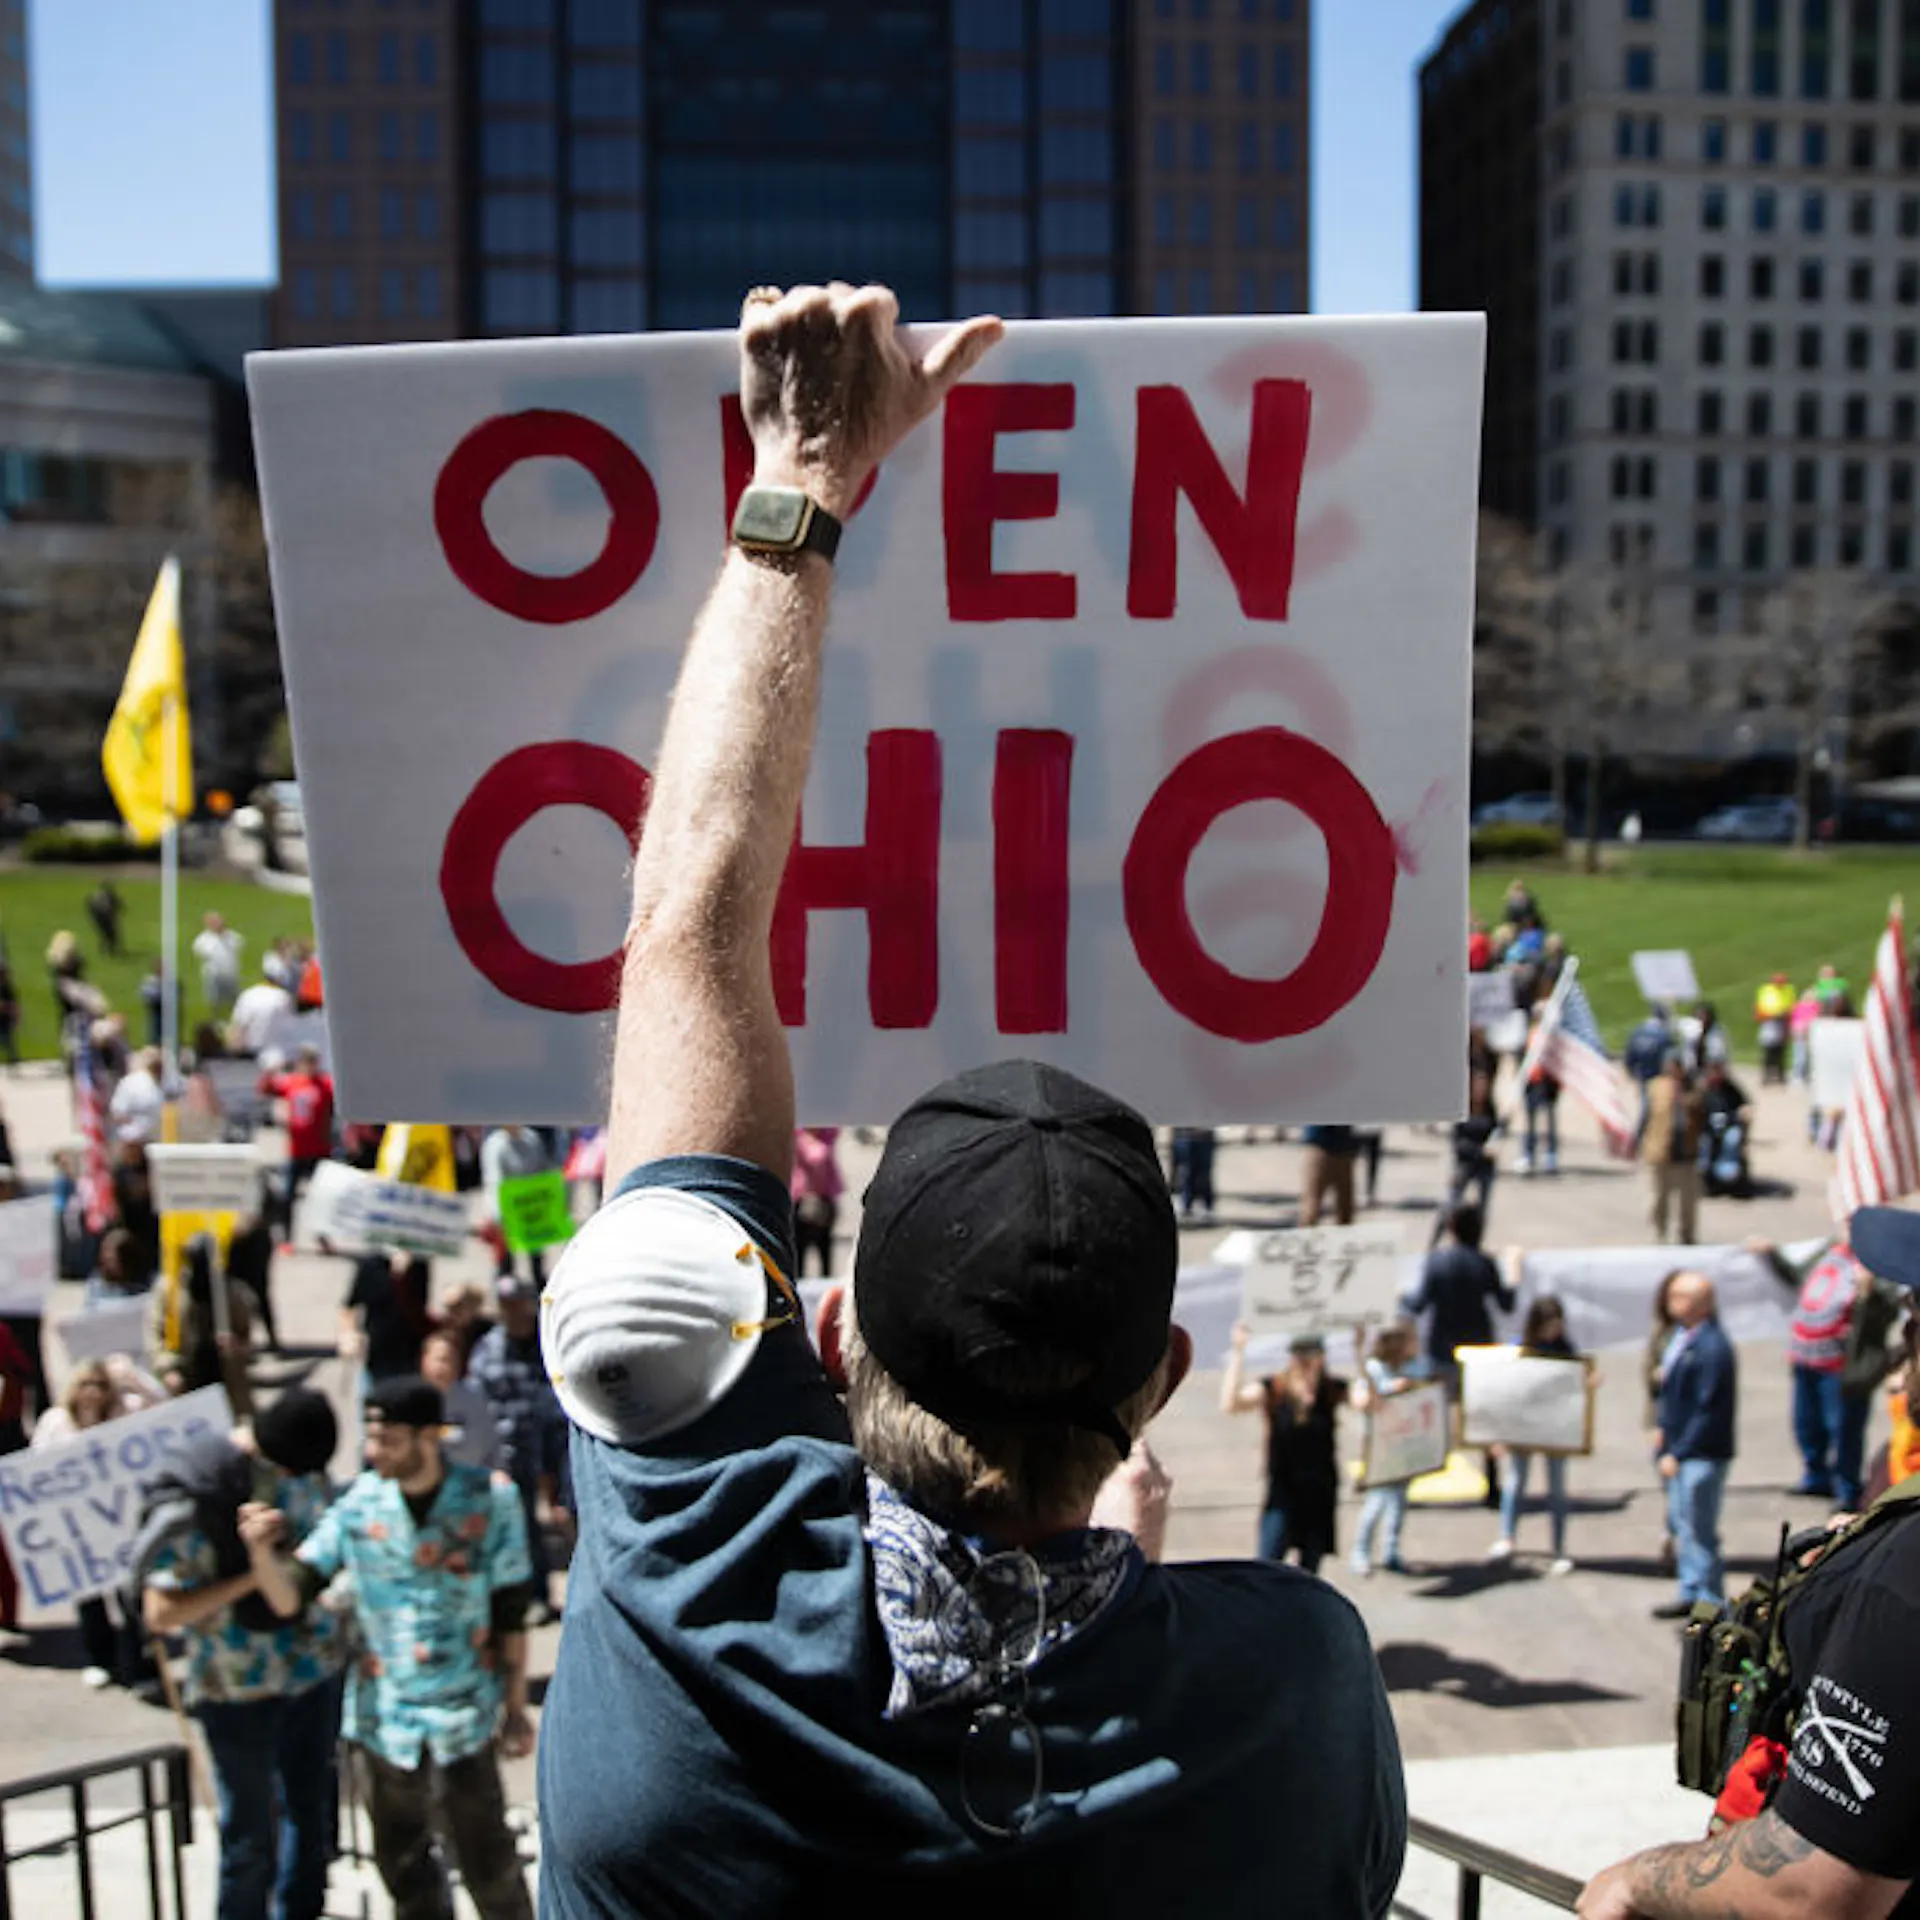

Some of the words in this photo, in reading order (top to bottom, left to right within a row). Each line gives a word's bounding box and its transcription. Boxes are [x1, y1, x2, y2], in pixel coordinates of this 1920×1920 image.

[435, 379, 1311, 624] OEN
[440, 727, 1396, 1042] OHIO
[17, 1483, 129, 1551] CIV
